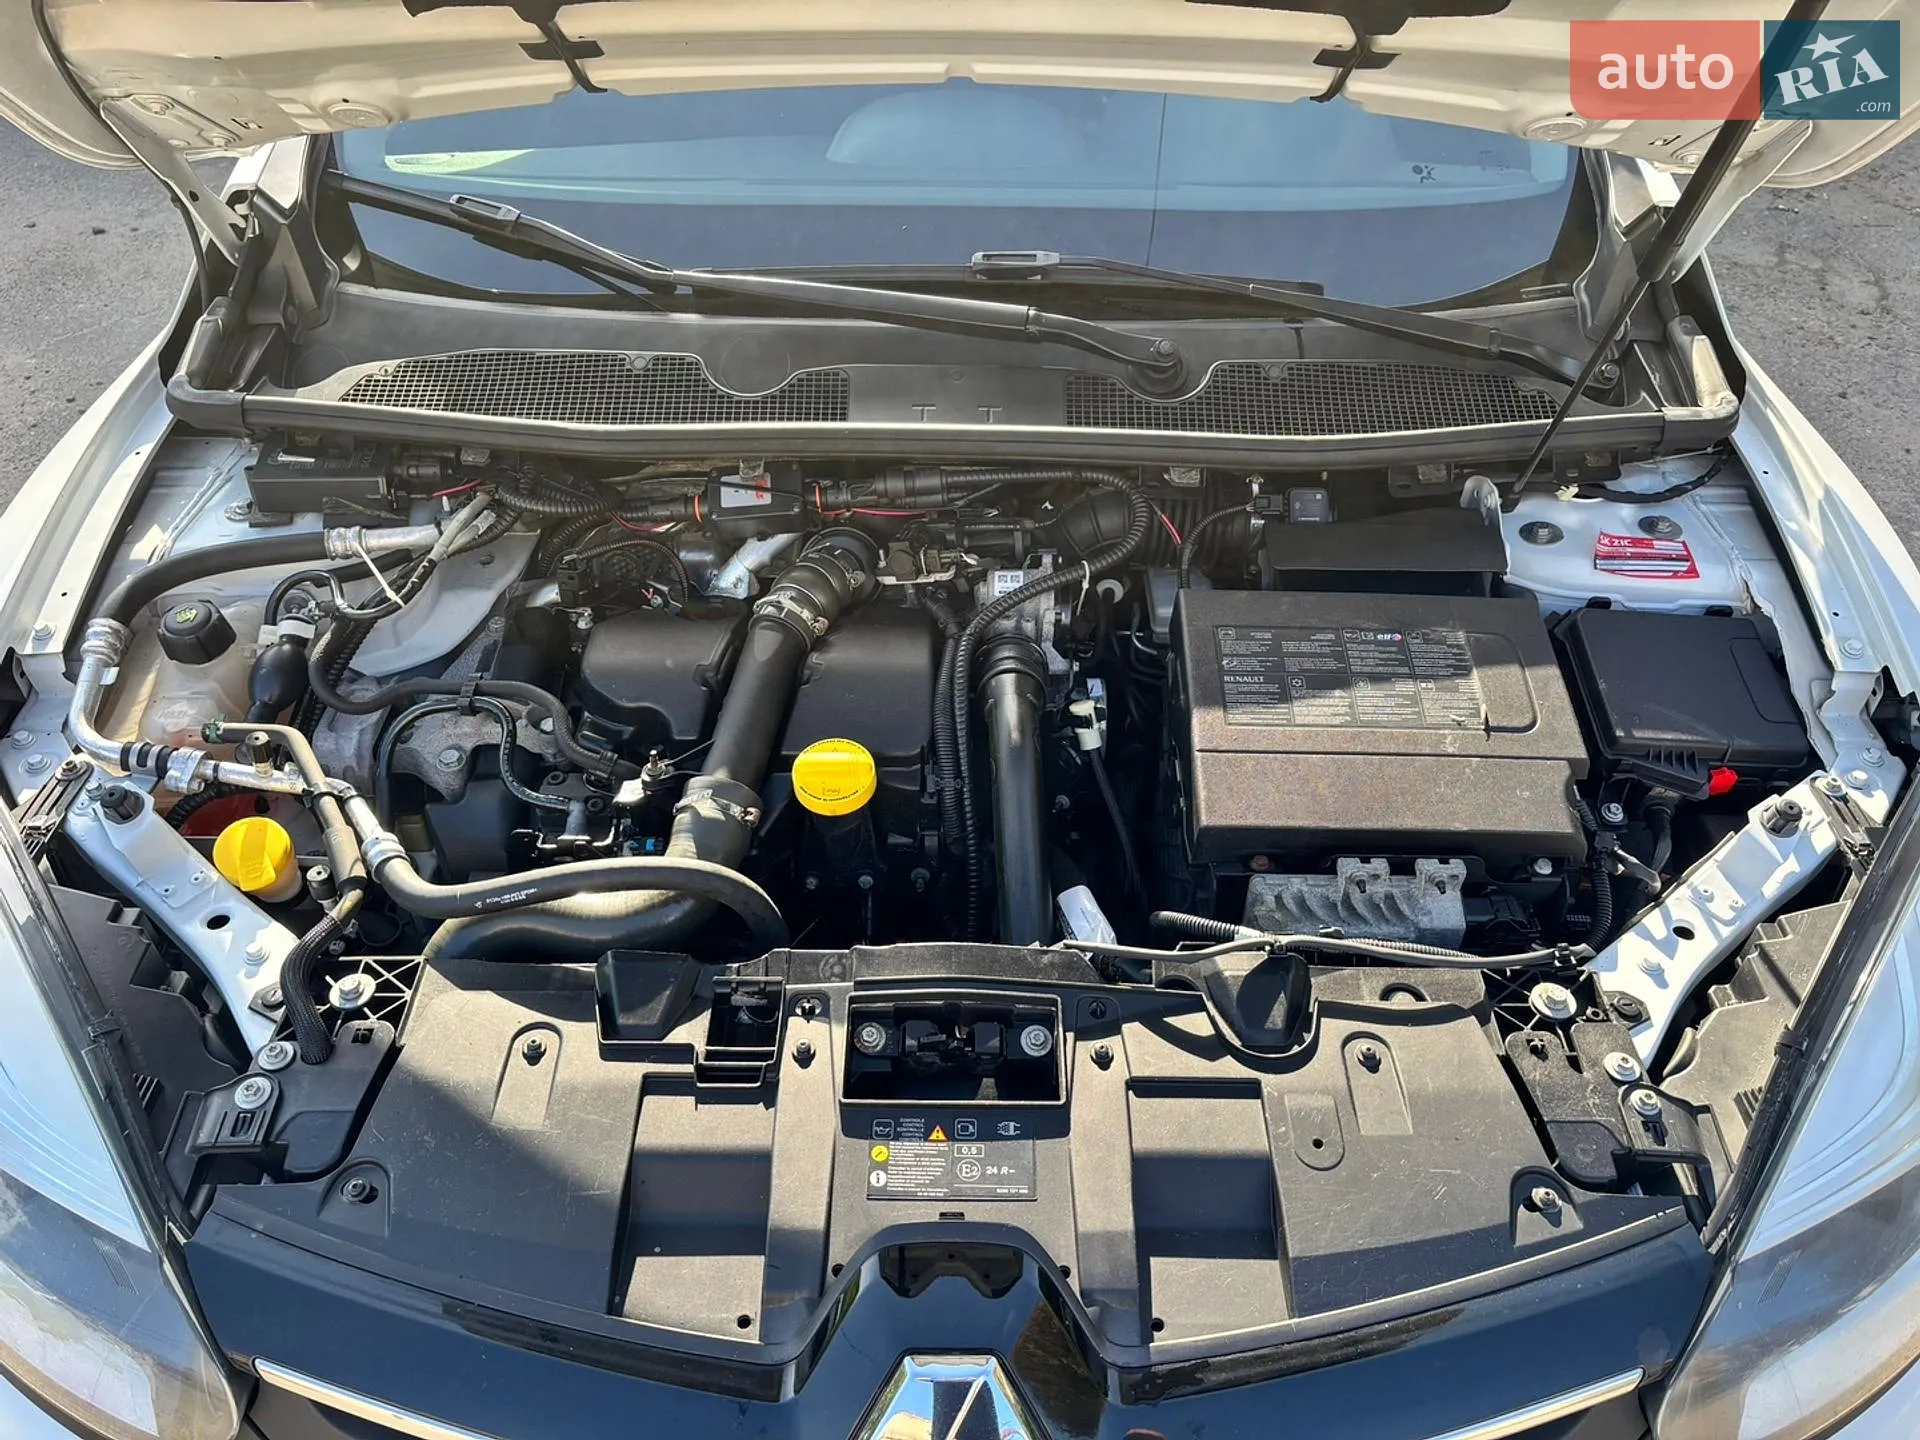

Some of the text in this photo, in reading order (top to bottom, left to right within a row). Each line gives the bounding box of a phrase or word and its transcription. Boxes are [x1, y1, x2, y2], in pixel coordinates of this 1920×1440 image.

[1612, 539, 1634, 547] ZIC
[1223, 675, 1265, 683] RENAULT
[961, 1163, 979, 1177] E2
[985, 1165, 998, 1175] 24
